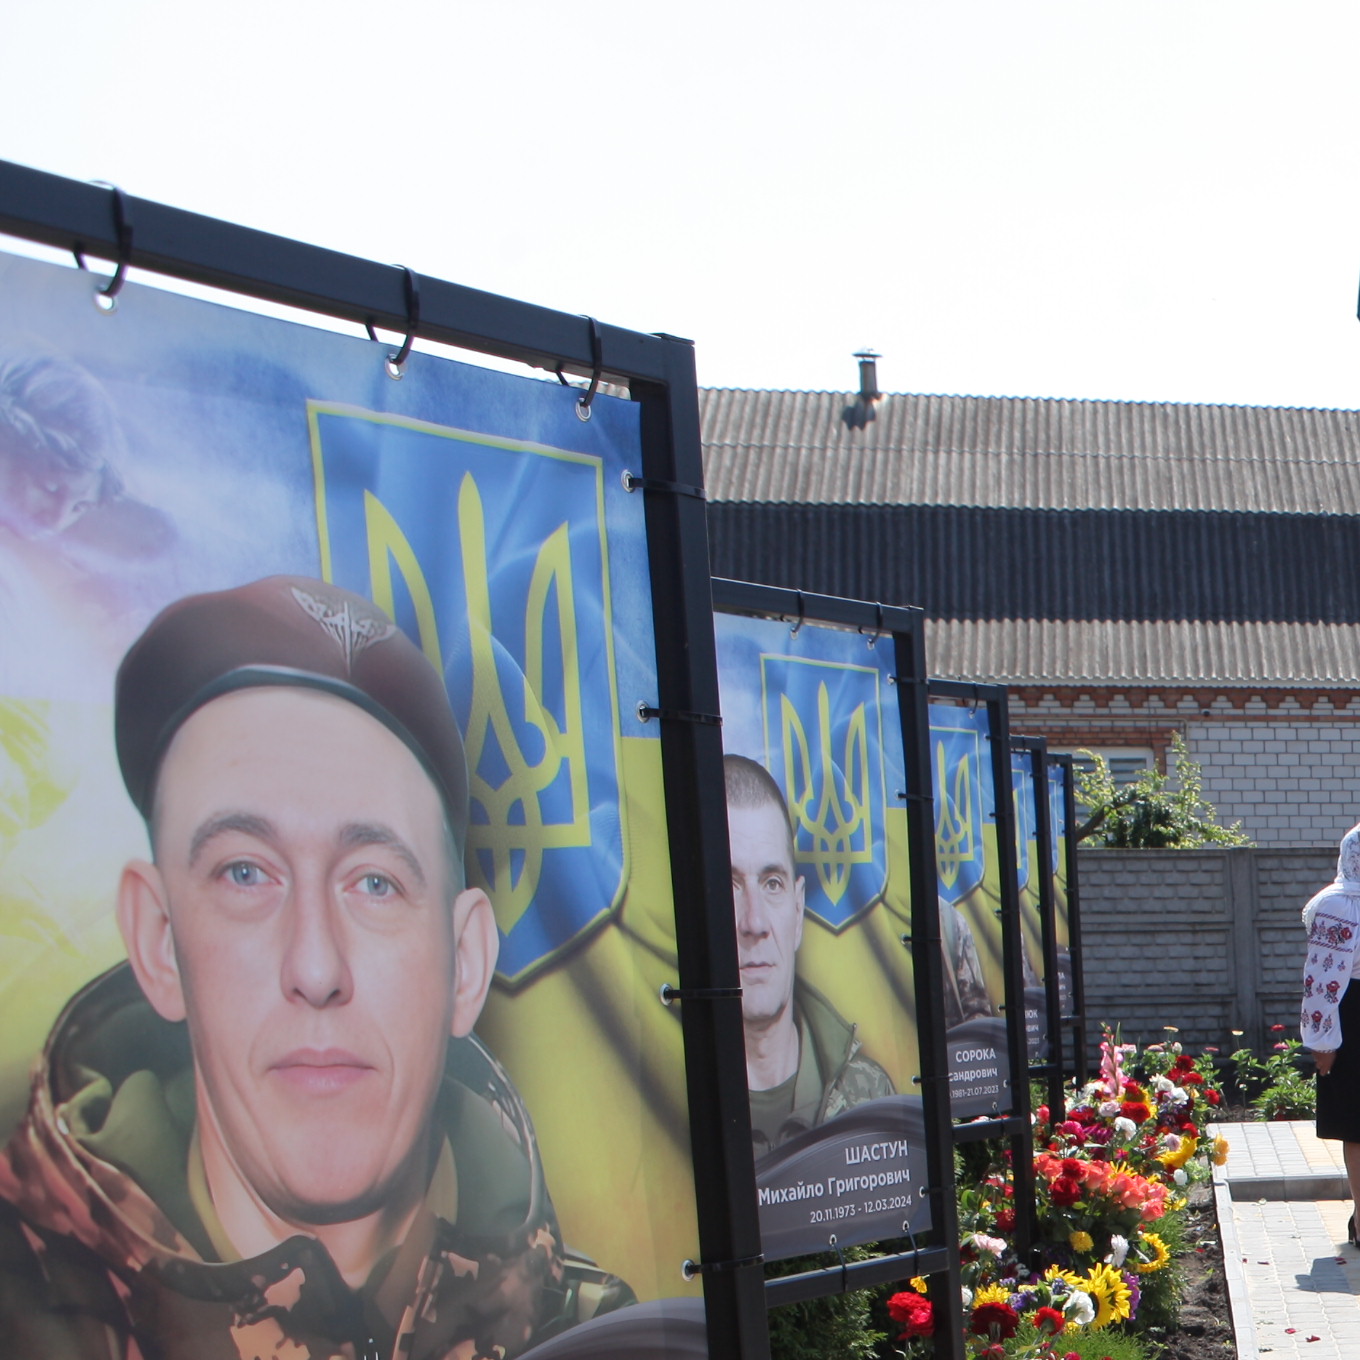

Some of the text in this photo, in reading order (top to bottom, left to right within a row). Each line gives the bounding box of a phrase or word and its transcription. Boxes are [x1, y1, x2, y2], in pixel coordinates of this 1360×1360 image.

[955, 1048, 997, 1063] СОРОКА
[845, 1139, 908, 1165] ШАСТУН
[758, 1168, 911, 1206] Михайло Григорович
[809, 1204, 856, 1223] 20.11.1973
[864, 1194, 912, 1213] 12.03.2024
